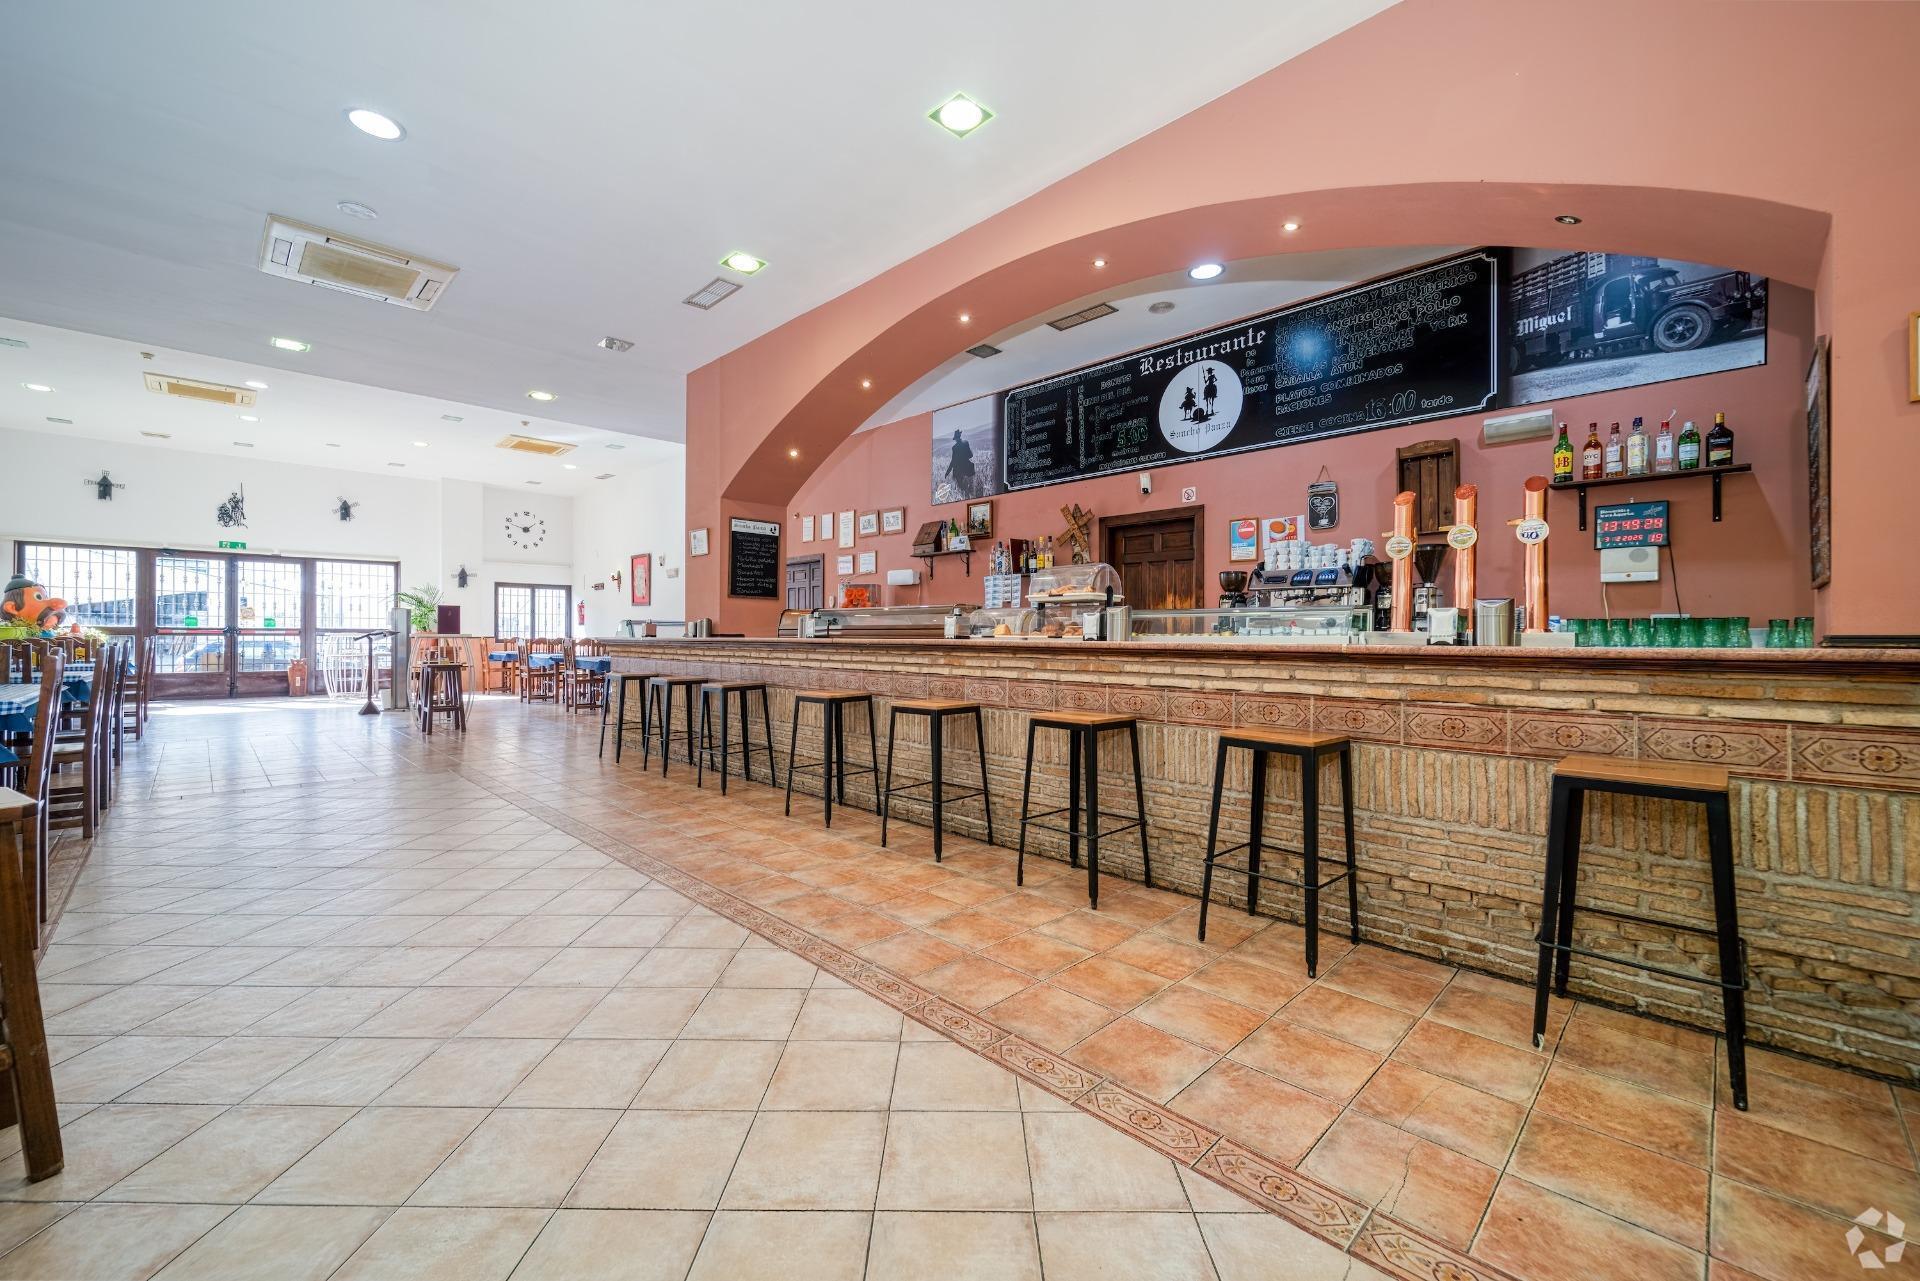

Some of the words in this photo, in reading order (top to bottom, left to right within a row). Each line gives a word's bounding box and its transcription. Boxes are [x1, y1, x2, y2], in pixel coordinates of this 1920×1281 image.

[1337, 289, 1417, 317] SALCHICON
[1420, 272, 1477, 296] IBERICO
[1381, 273, 1434, 298] IBERICO
[1373, 311, 1410, 330] LOMO
[1417, 296, 1461, 314] POLLO
[1393, 292, 1441, 312] FRESCO
[1335, 322, 1398, 348] ENTRECOT
[1430, 313, 1468, 331] YORK
[1516, 305, 1574, 336] Miguel
[1140, 327, 1266, 376] Restaurante
[1276, 359, 1328, 381] ANCAS
[1331, 337, 1415, 364] BOQUERONES
[1275, 369, 1323, 389] CABALLA
[1331, 360, 1364, 376] ATUN
[1276, 386, 1317, 404] PLATOS
[1320, 364, 1404, 392] COMBINADOS
[1276, 393, 1333, 415] RACIONES
[1276, 421, 1314, 437] CIERRE
[1319, 411, 1366, 428] COCINA
[1365, 389, 1417, 422] 16:00
[1421, 395, 1454, 408] tarde
[1169, 426, 1201, 441] Sancho
[1205, 420, 1232, 436] Panza
